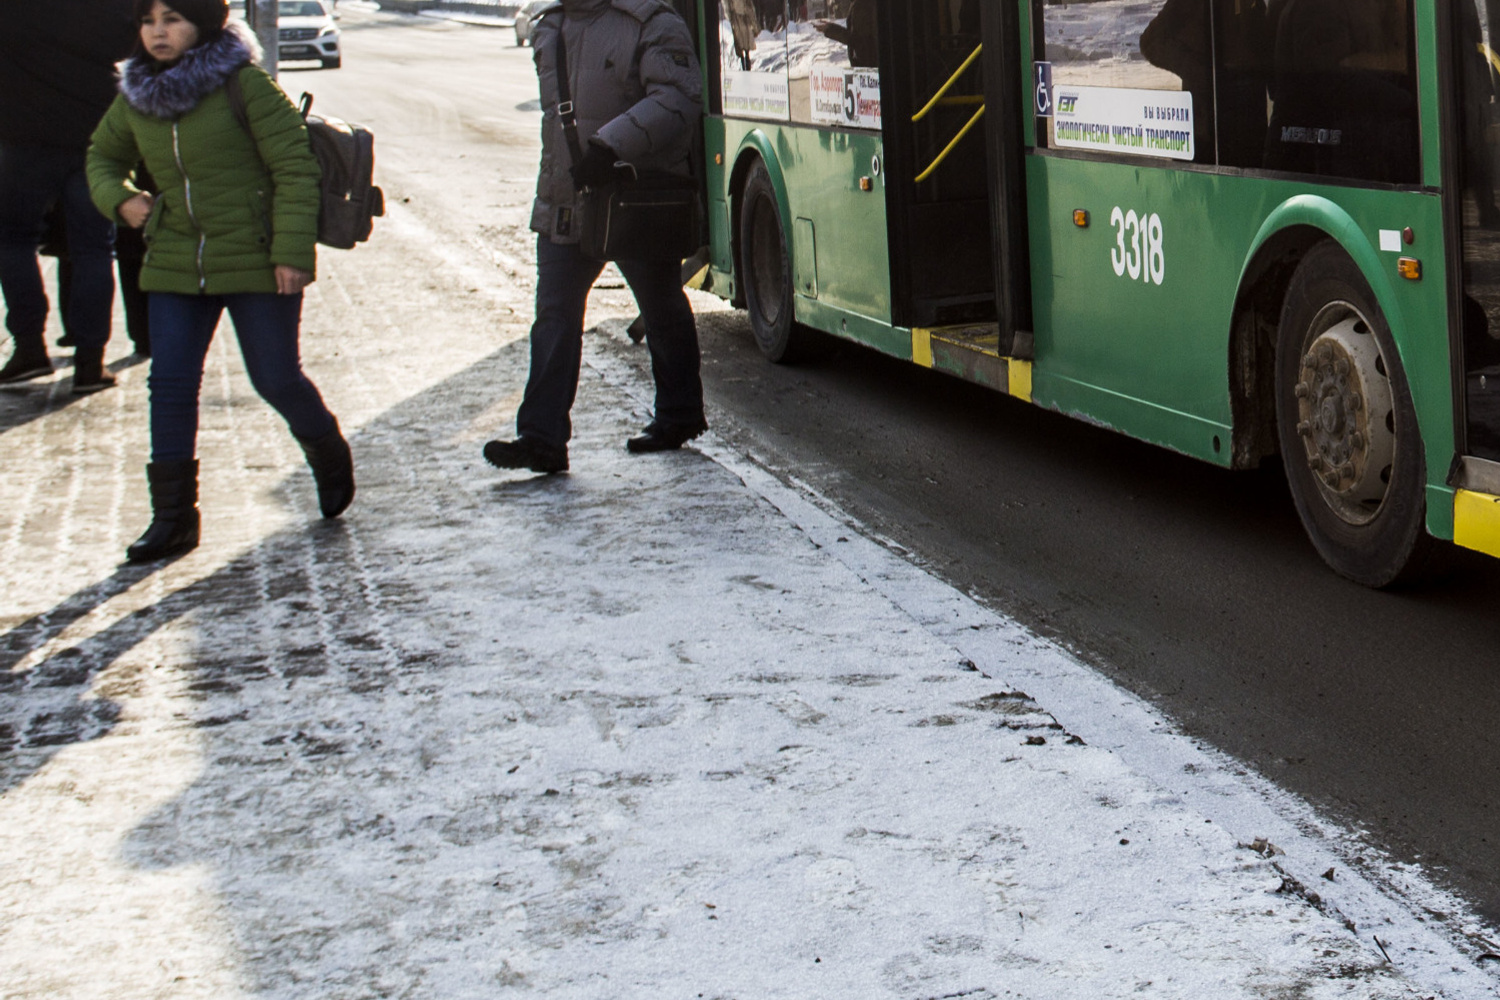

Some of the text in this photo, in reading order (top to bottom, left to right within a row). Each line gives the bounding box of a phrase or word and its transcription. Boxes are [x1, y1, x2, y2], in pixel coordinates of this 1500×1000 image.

[844, 74, 855, 121] 5
[1144, 106, 1190, 122] ВЫ ВЫБРАЛИ
[1056, 120, 1190, 152] ЭКОЛОГИЧЕСКИ ЧИСТЫЙ ТРАНСПОРТ
[1110, 205, 1165, 286] 3318
